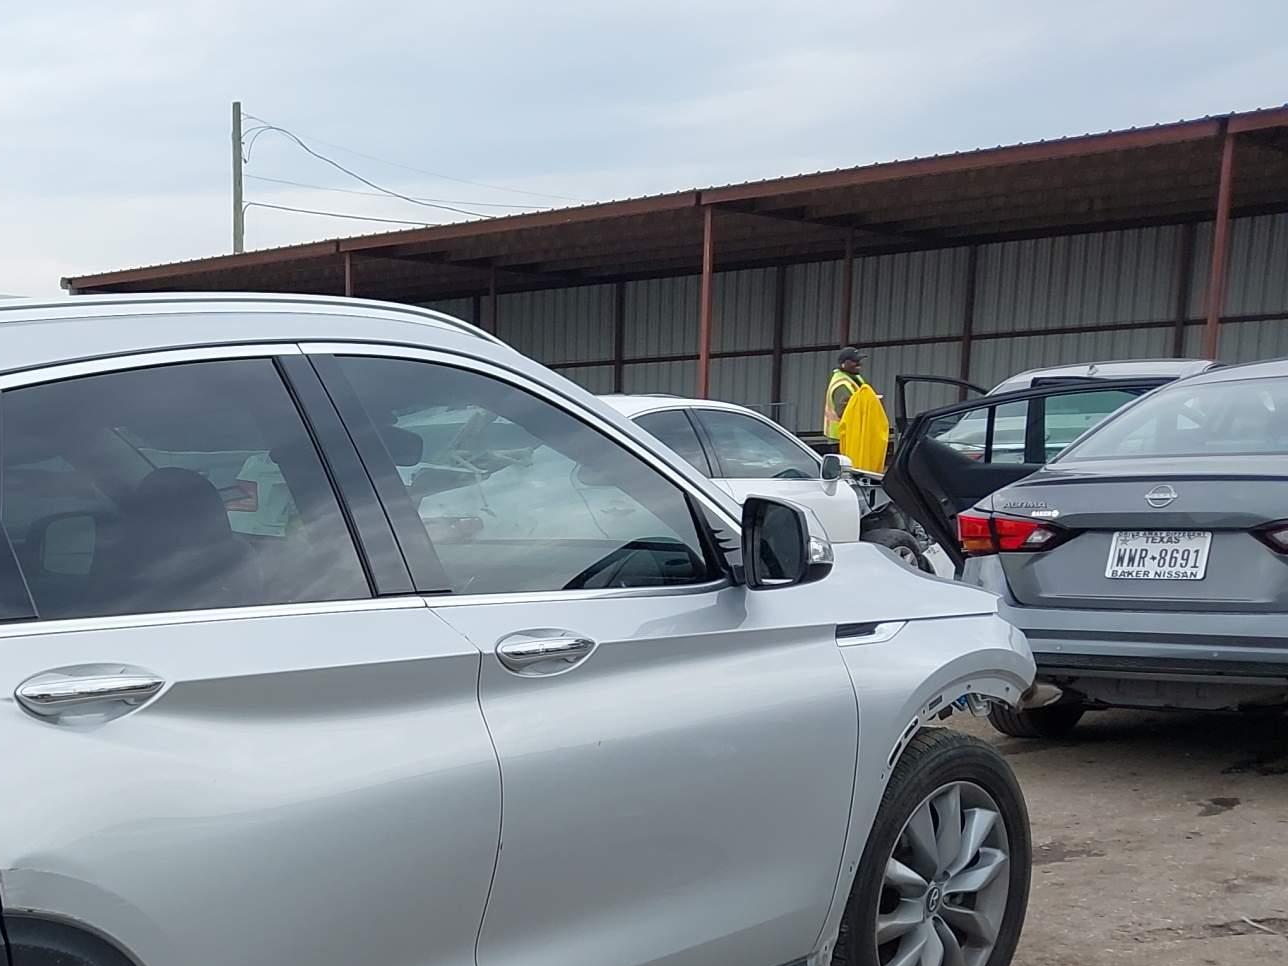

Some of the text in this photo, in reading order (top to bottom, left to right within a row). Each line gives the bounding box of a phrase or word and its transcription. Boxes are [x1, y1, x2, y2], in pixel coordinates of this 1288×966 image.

[1003, 501, 1048, 509] ALTIMA
[1144, 536, 1180, 544] TEXAS
[1111, 569, 1198, 579] BAKER NISSAN
